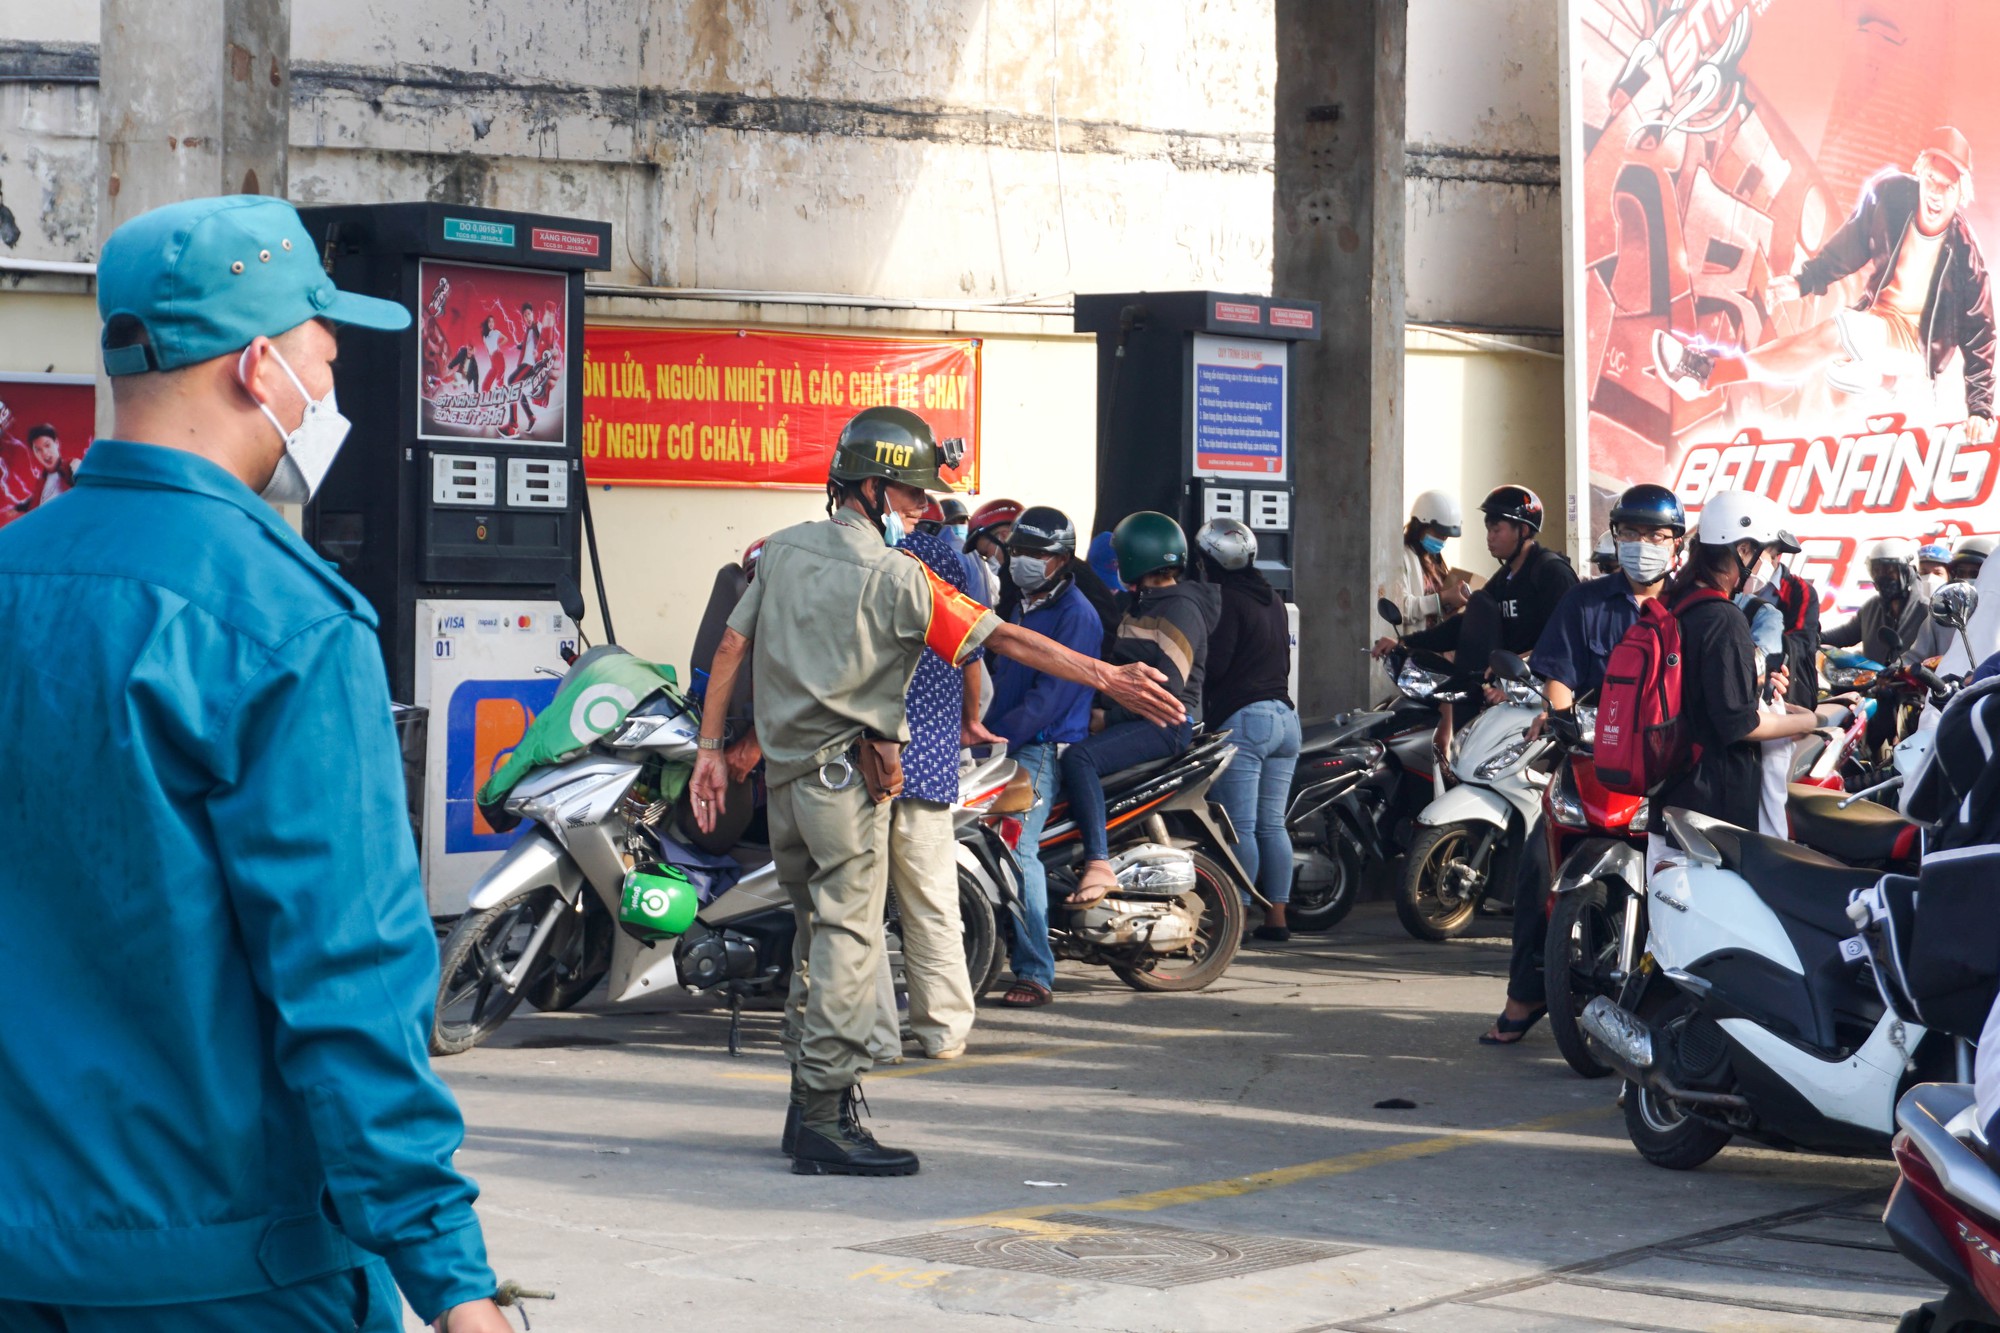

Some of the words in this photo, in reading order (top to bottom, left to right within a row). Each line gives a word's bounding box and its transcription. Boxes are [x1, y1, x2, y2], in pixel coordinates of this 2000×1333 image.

[460, 222, 471, 231] DO
[561, 235, 592, 246] RON95-V
[611, 350, 651, 404] LỬA,
[656, 353, 719, 402] NGUỒN
[724, 360, 776, 411] NHIỆT
[780, 361, 804, 404] VÀ
[808, 362, 844, 406] CÁC
[848, 360, 894, 407] CHẤT
[923, 367, 968, 410] CHÁY
[606, 422, 661, 459] NGUY
[667, 421, 694, 460] CƠ
[700, 418, 755, 467] CHÁY,
[760, 413, 789, 463] NỔ
[875, 440, 914, 468] TTGT
[1788, 414, 1998, 510] NĂNG
[444, 616, 465, 629] VISA
[436, 640, 450, 657] 01
[566, 820, 597, 829] HONDA
[631, 886, 642, 910] gojek
